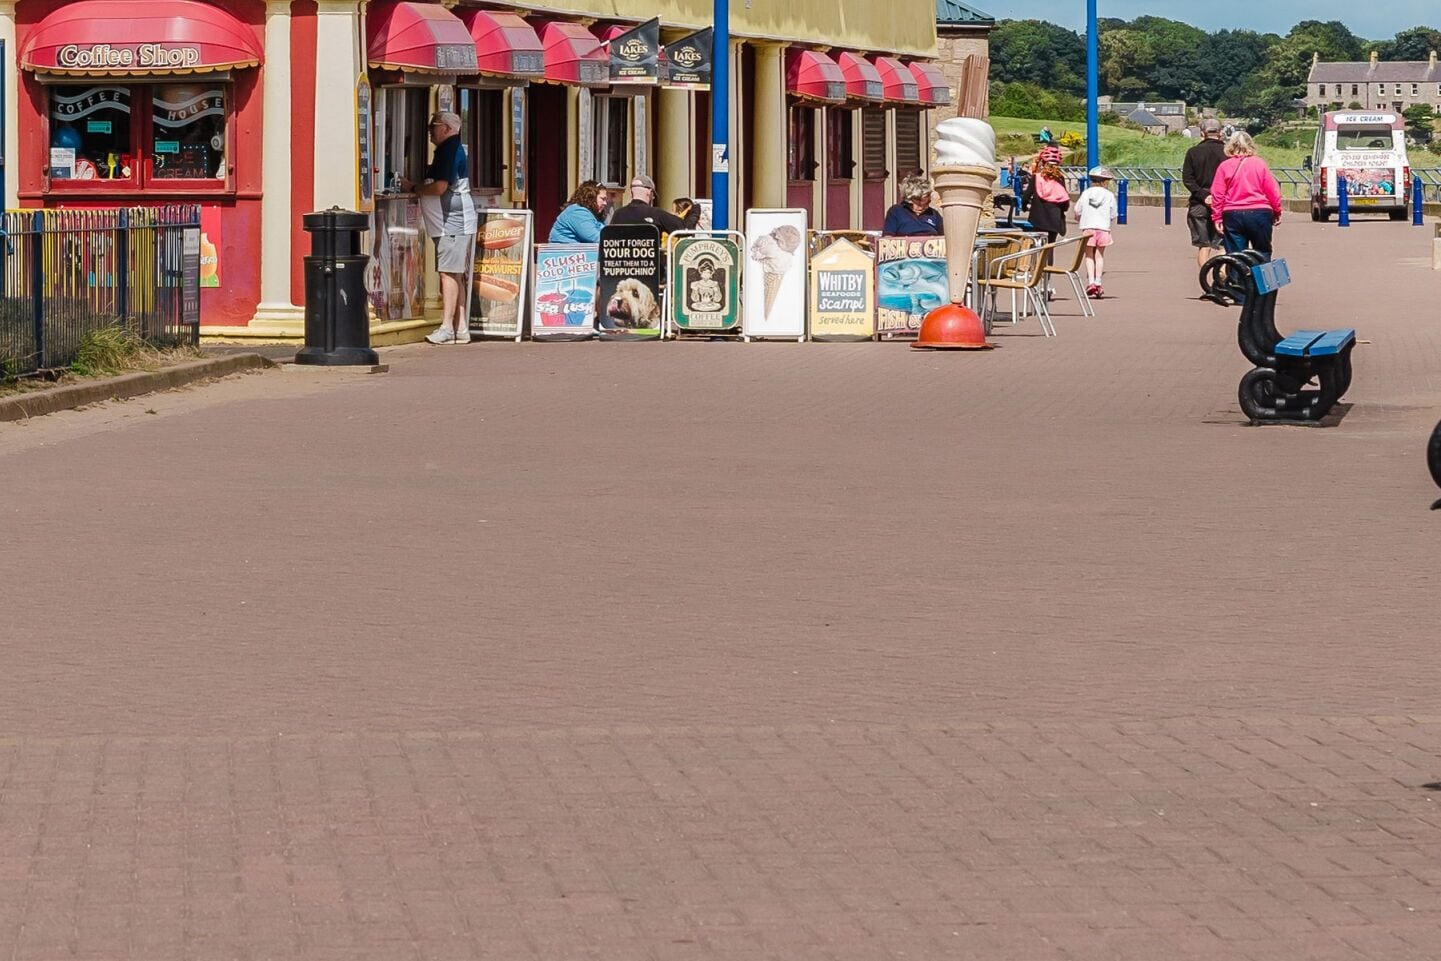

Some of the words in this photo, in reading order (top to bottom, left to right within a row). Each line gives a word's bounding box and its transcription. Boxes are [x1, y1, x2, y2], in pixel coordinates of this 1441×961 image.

[59, 43, 134, 68] Coffee
[138, 43, 200, 68] Shop
[620, 45, 648, 57] LAKES
[674, 51, 701, 63] LAKES
[57, 91, 121, 114] COFFEE
[167, 97, 222, 121] HOUSE
[159, 168, 204, 179] CREAM
[478, 226, 524, 240] Rollover
[603, 239, 626, 248] DON'T
[628, 239, 655, 248] FORGET
[879, 239, 907, 262] FISH
[924, 238, 947, 258] CHI
[544, 253, 586, 268] SLUSH
[603, 248, 631, 258] YOUR
[632, 248, 656, 258] DOG
[474, 264, 522, 275] BOCKWURST
[537, 268, 564, 278] SOLD
[568, 262, 596, 274] HERE
[818, 271, 864, 291] WHITBY
[819, 297, 865, 312] Scampi
[878, 307, 906, 331] FISH
